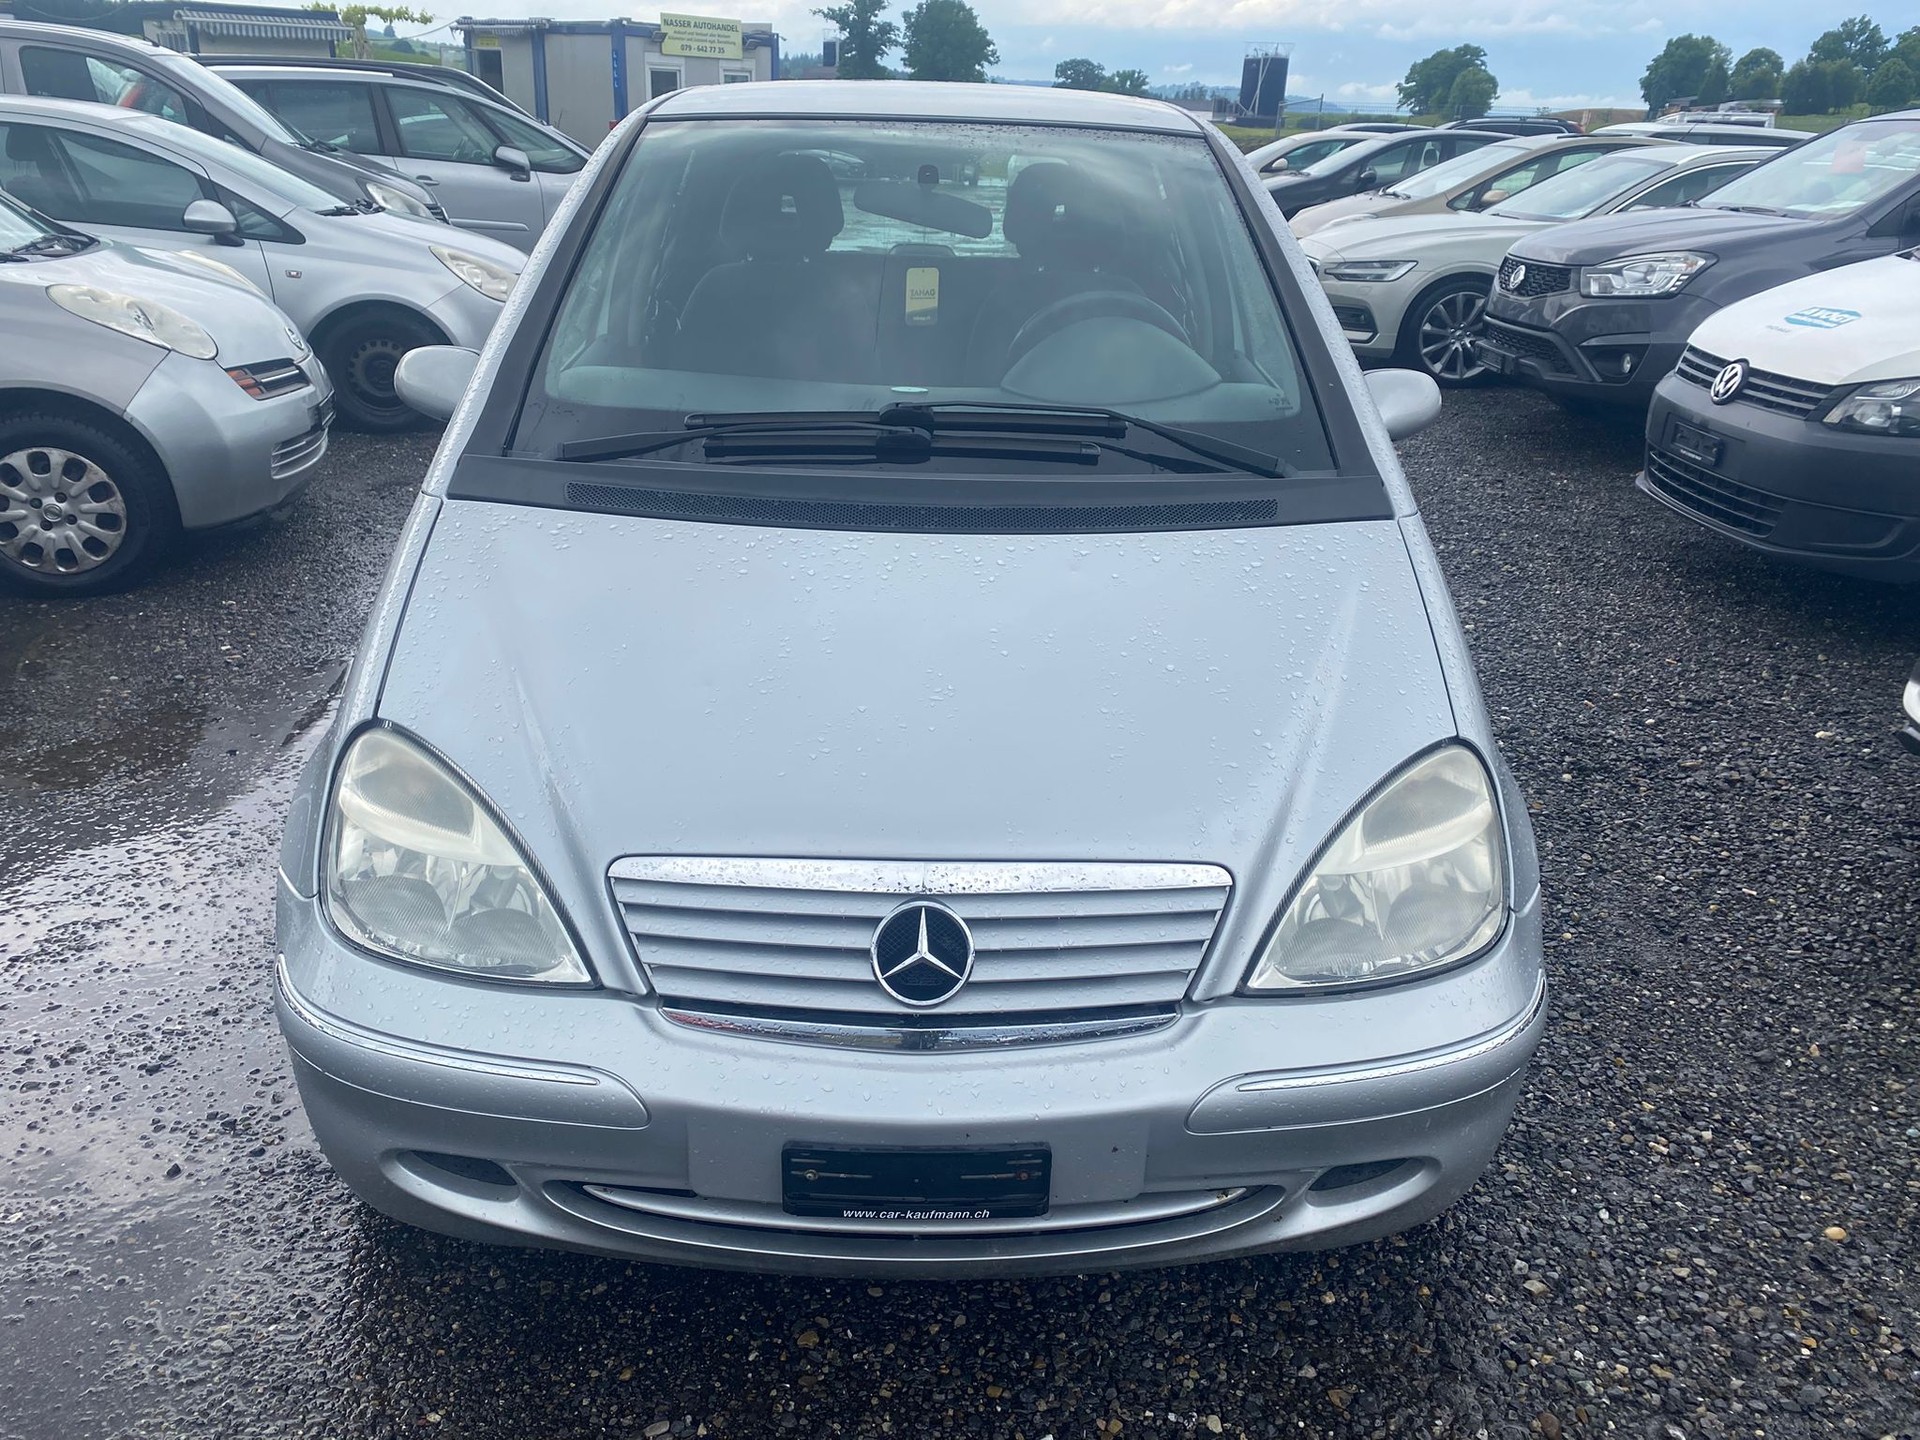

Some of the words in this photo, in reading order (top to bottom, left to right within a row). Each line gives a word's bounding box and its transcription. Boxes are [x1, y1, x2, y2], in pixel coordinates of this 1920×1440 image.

[663, 19, 691, 28] NASSER
[693, 21, 739, 32] AUTOHANDEL
[697, 45, 707, 53] 642
[843, 1209, 990, 1219] www.car-kaufmann.ch
